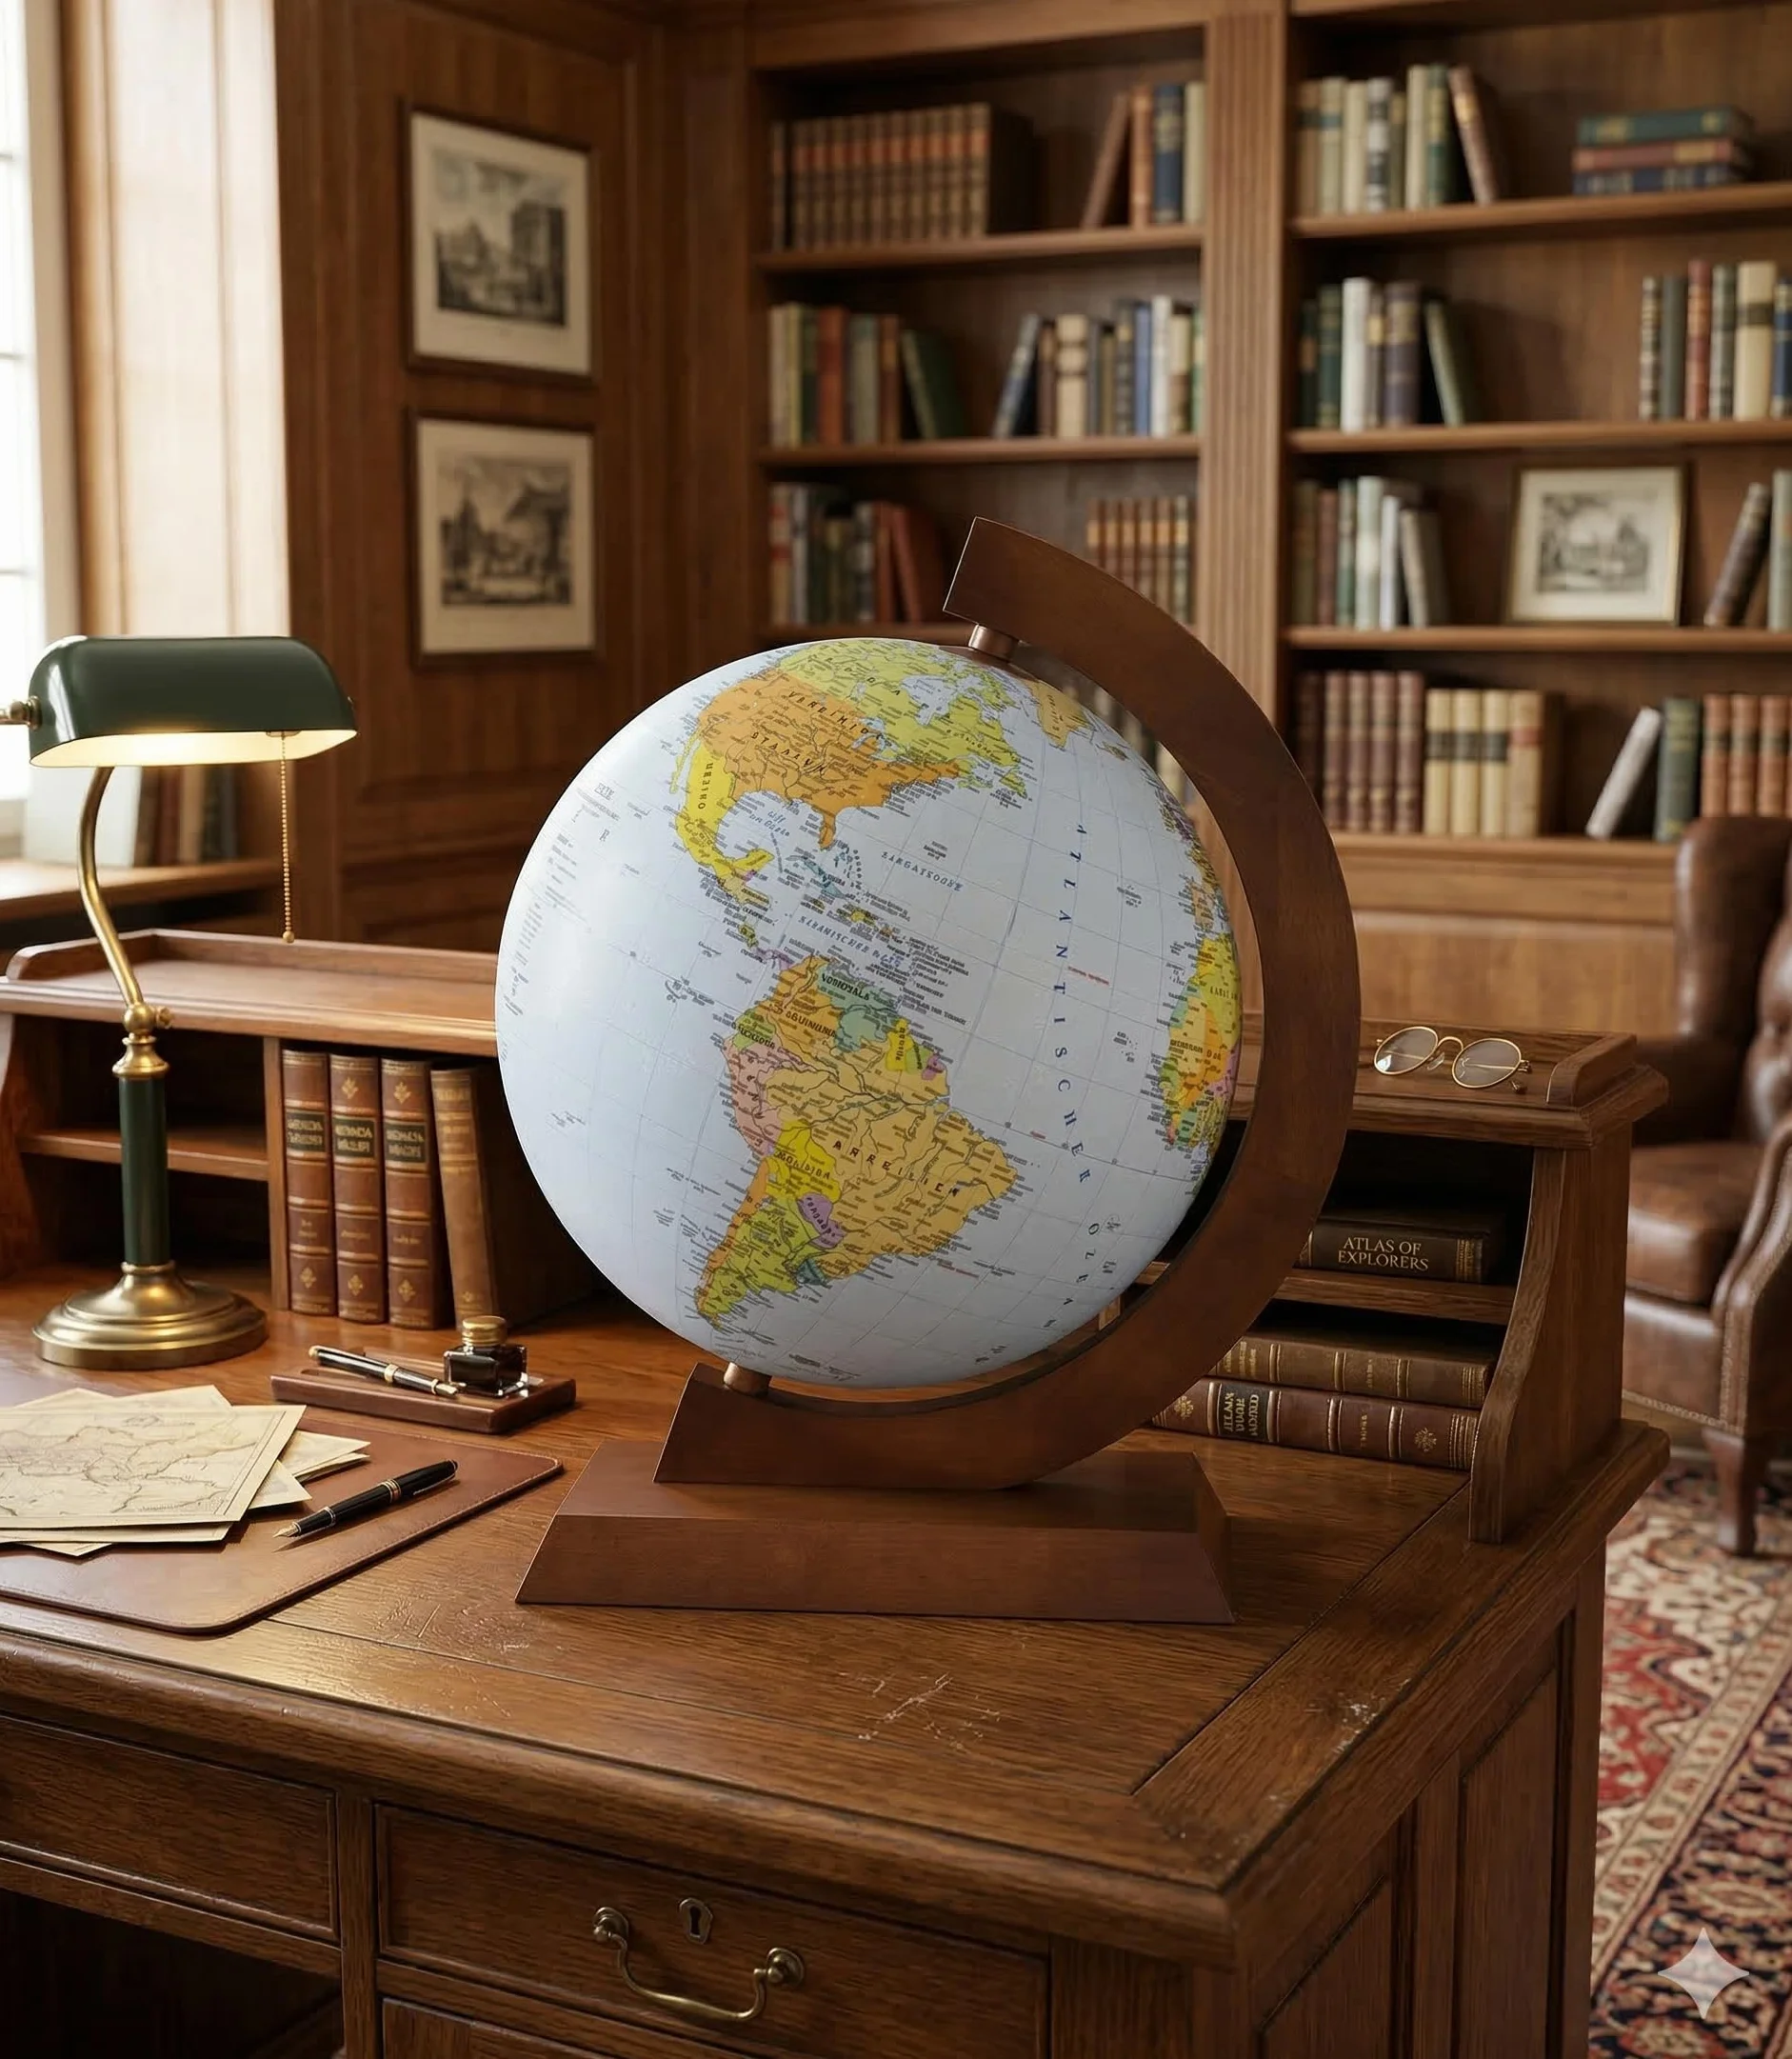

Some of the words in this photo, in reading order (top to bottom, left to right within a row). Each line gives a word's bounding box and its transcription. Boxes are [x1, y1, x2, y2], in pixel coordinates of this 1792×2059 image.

[1344, 1236, 1395, 1253] ATLAS
[1399, 1240, 1422, 1256] OF
[1338, 1250, 1429, 1271] EXPLORERS
